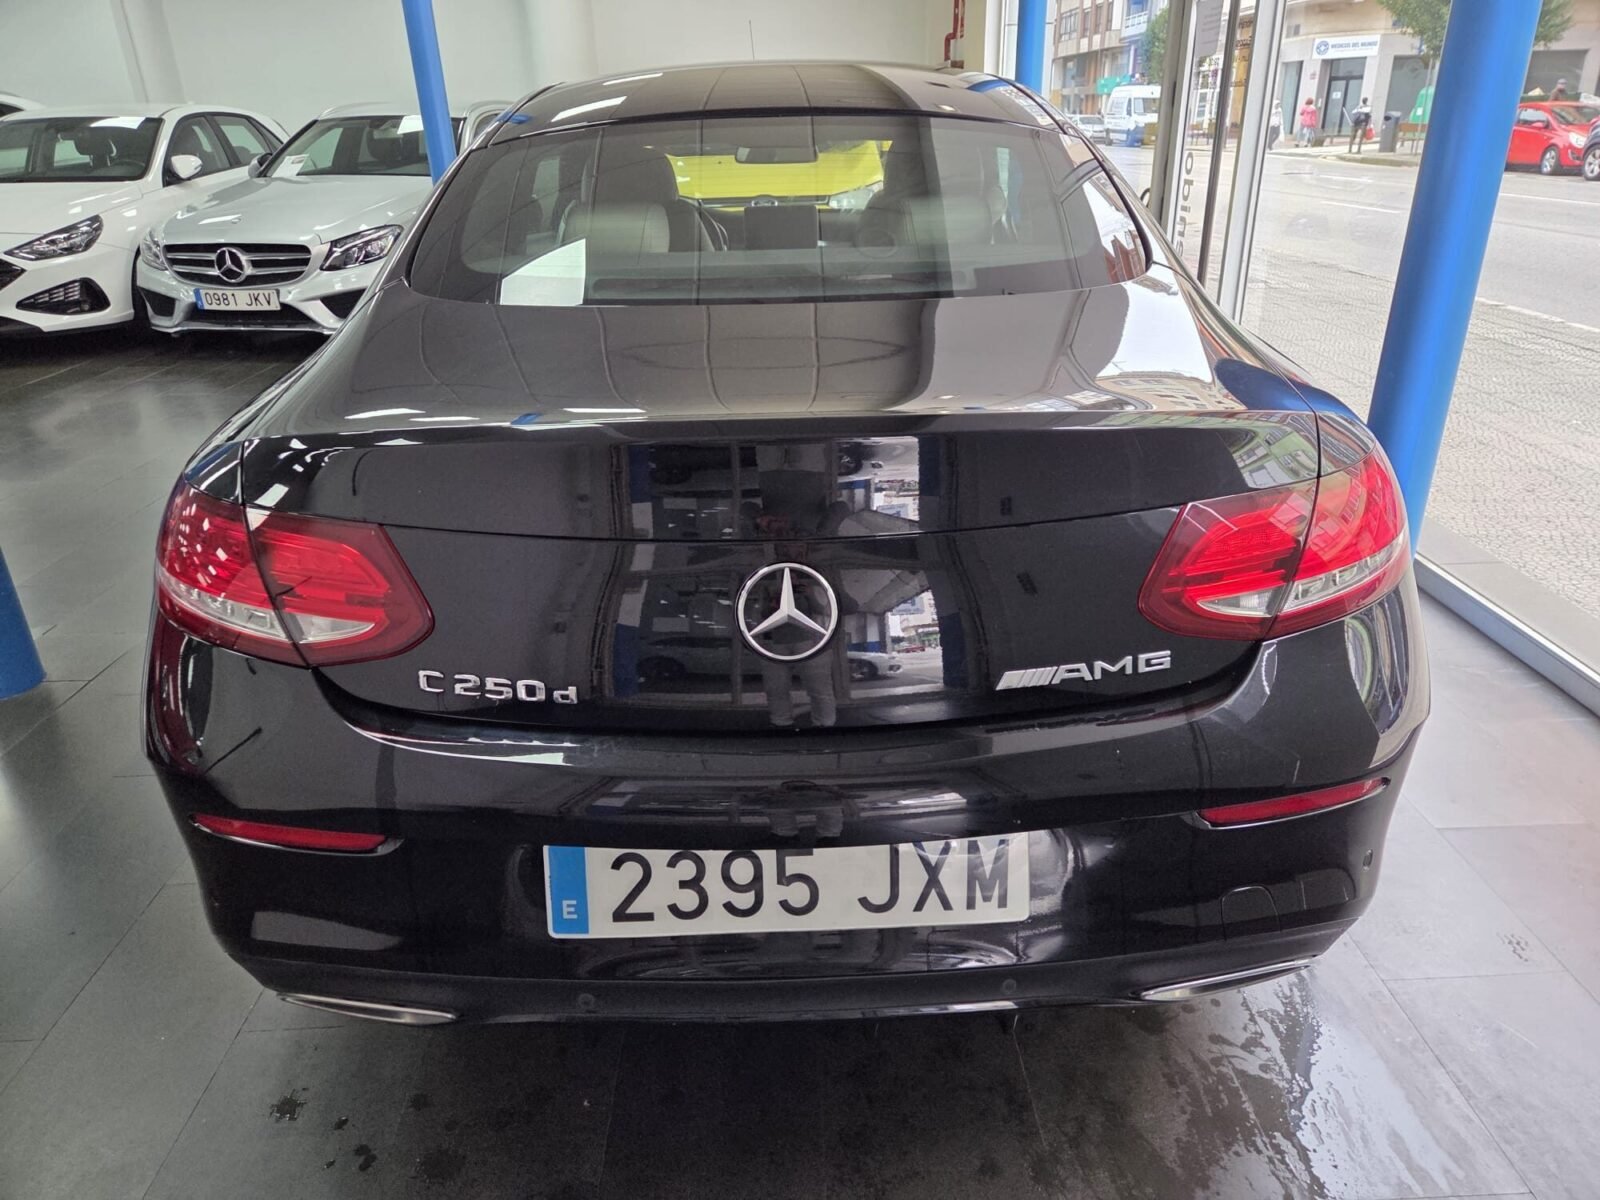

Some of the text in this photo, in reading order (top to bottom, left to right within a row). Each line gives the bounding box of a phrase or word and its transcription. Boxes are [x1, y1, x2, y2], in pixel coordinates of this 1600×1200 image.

[204, 292, 238, 306] 0981
[245, 292, 271, 307] JKV
[1051, 650, 1171, 684] AMG
[418, 670, 578, 704] C 250 d
[610, 838, 1009, 922] 2395 JXM
[562, 900, 578, 919] E
